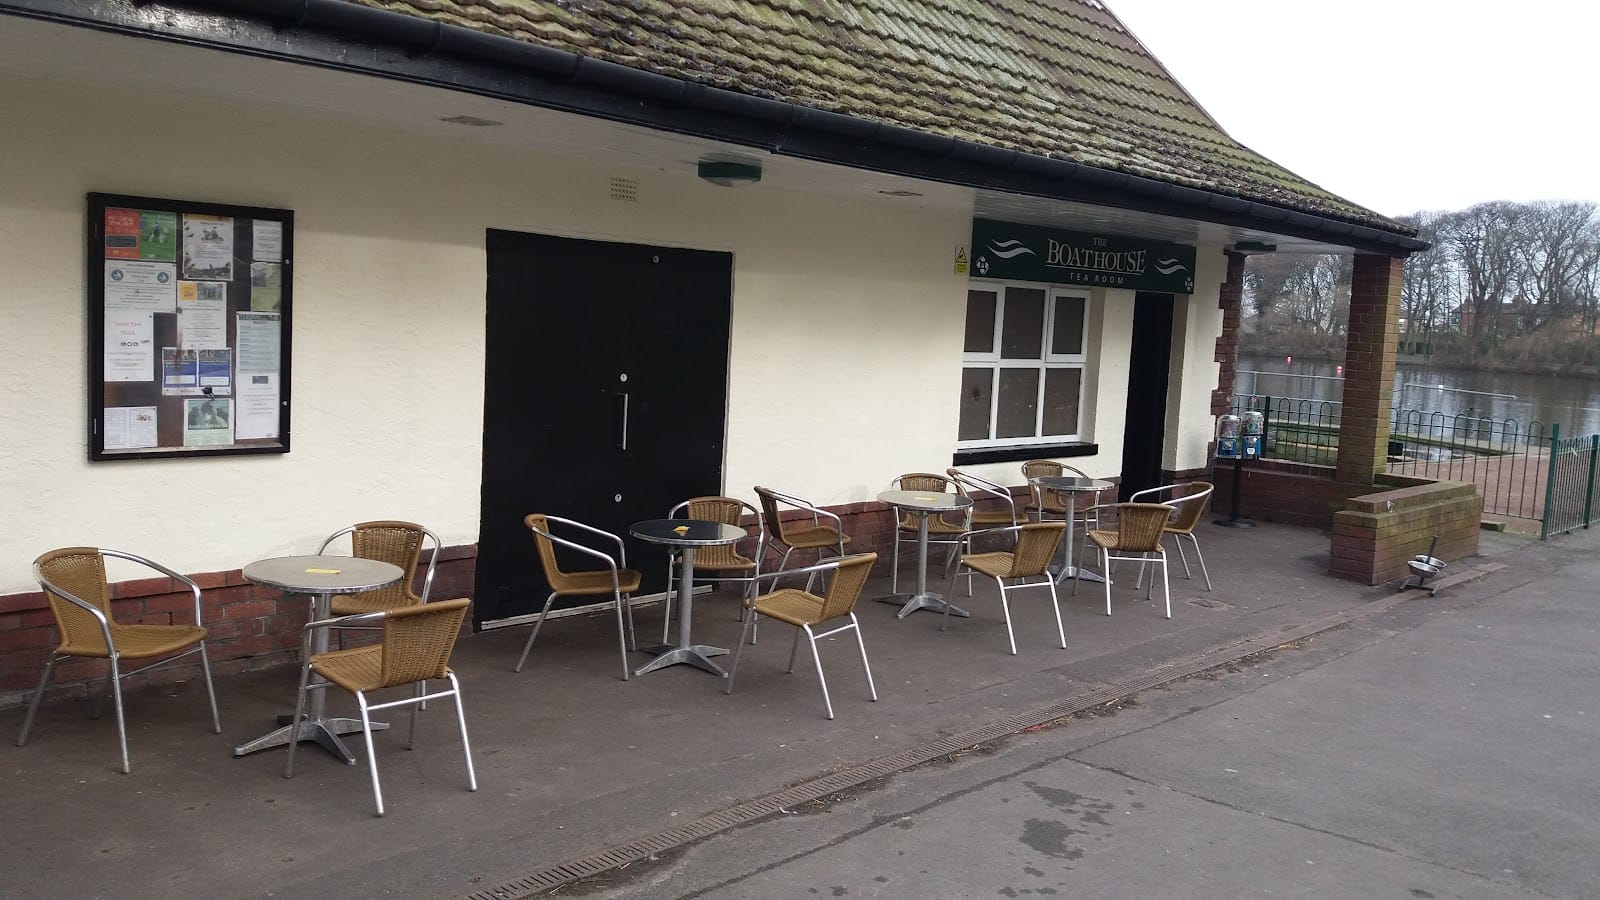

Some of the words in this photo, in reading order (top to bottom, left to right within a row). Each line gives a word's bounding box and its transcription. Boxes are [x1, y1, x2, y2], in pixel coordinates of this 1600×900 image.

[1094, 237, 1108, 247] THE
[1045, 238, 1147, 274] BOATHOUSE
[1070, 272, 1089, 281] TEA
[1094, 274, 1124, 285] ROOM
